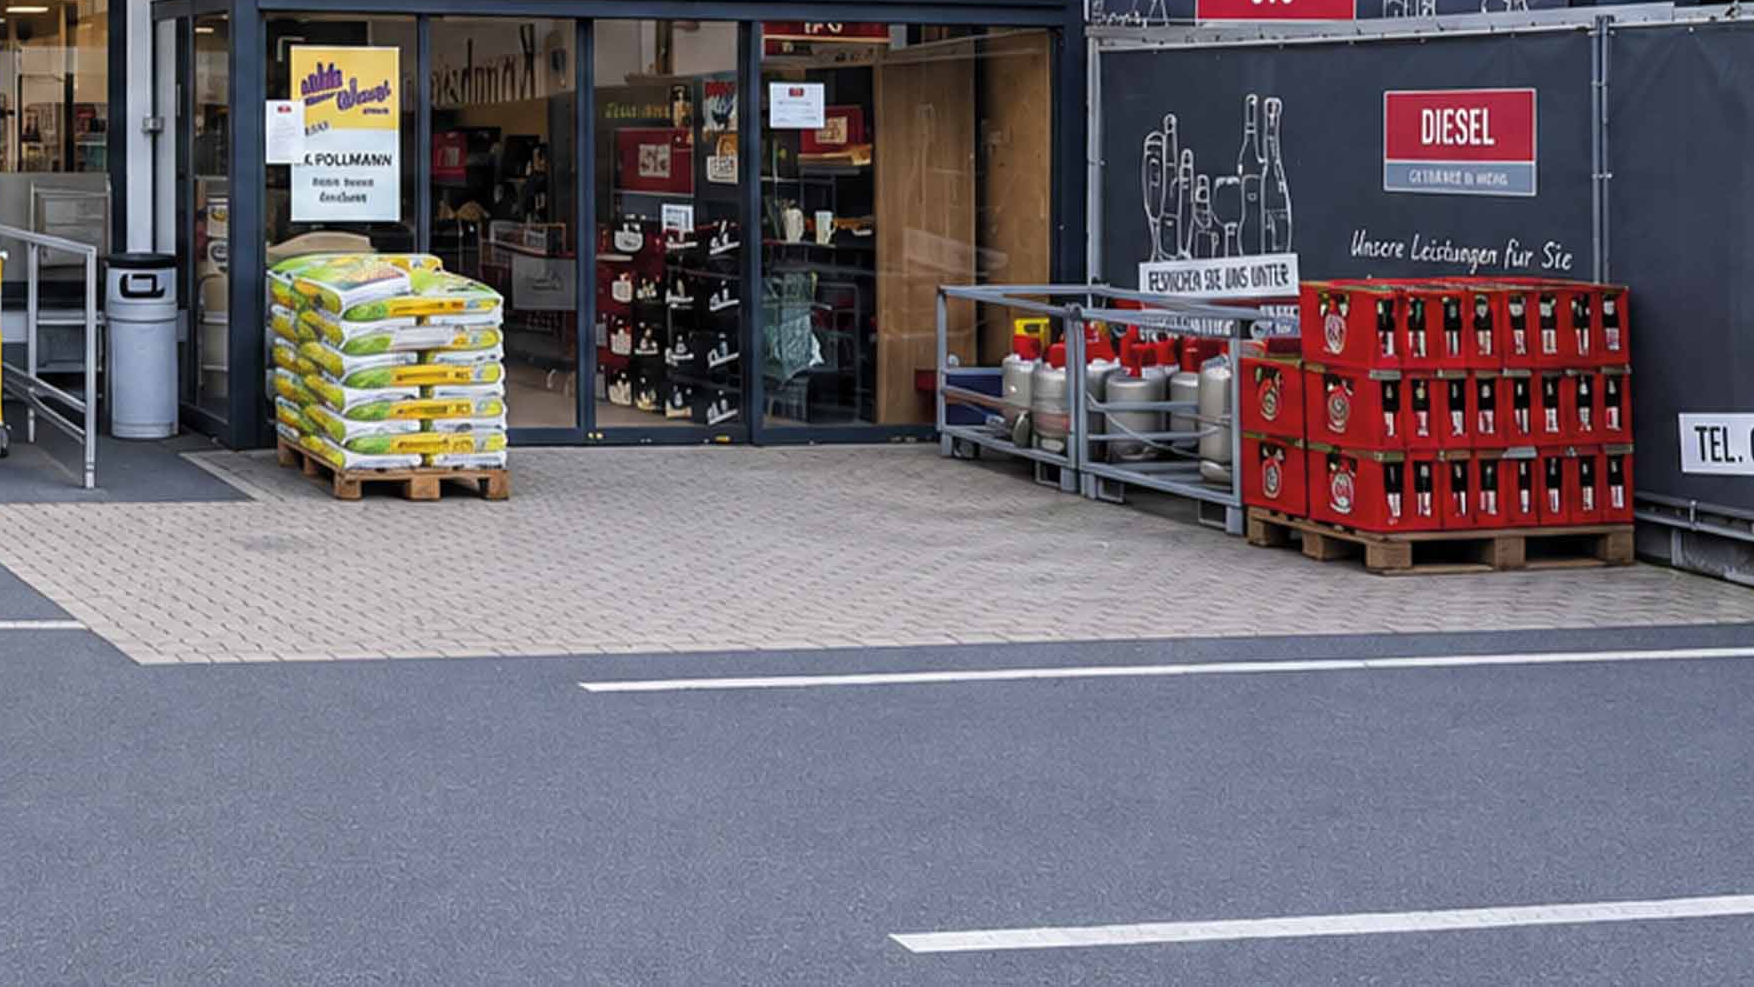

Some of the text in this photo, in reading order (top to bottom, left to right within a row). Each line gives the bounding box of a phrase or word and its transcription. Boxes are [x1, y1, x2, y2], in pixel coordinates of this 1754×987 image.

[1421, 107, 1495, 146] DIESEL
[315, 152, 393, 166] POLLMANN
[1351, 229, 1404, 258] Unsere
[1542, 241, 1573, 271] Sie
[1694, 425, 1743, 462] TEL.
